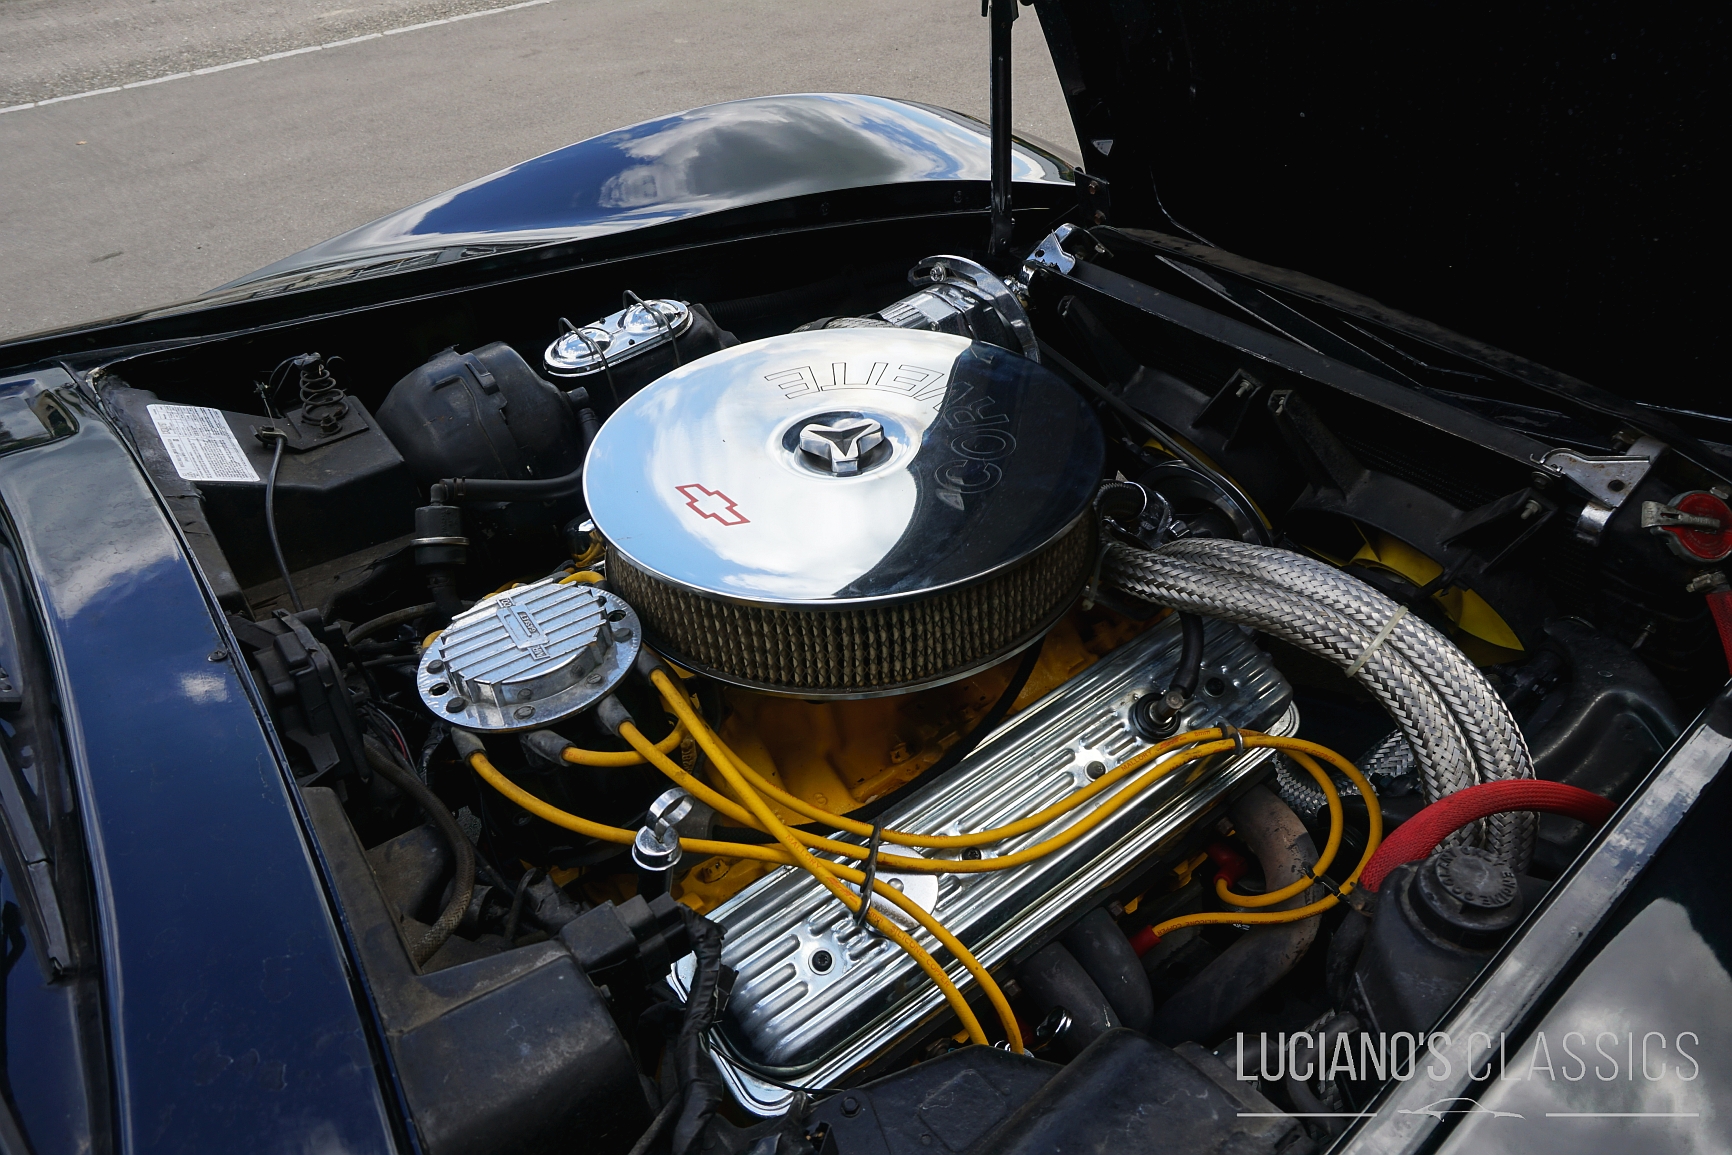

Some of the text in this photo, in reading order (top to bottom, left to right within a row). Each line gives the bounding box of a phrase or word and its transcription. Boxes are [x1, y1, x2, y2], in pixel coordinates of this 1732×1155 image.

[764, 361, 1017, 494] CORVETTE
[562, 750, 586, 760] PPER
[1121, 750, 1152, 771] MALLORY
[786, 834, 821, 869] MALLORY
[1479, 871, 1516, 906] ENGINE
[1157, 923, 1182, 936] COPPER
[890, 925, 926, 958] SILICONE
[926, 958, 950, 988] COPPER
